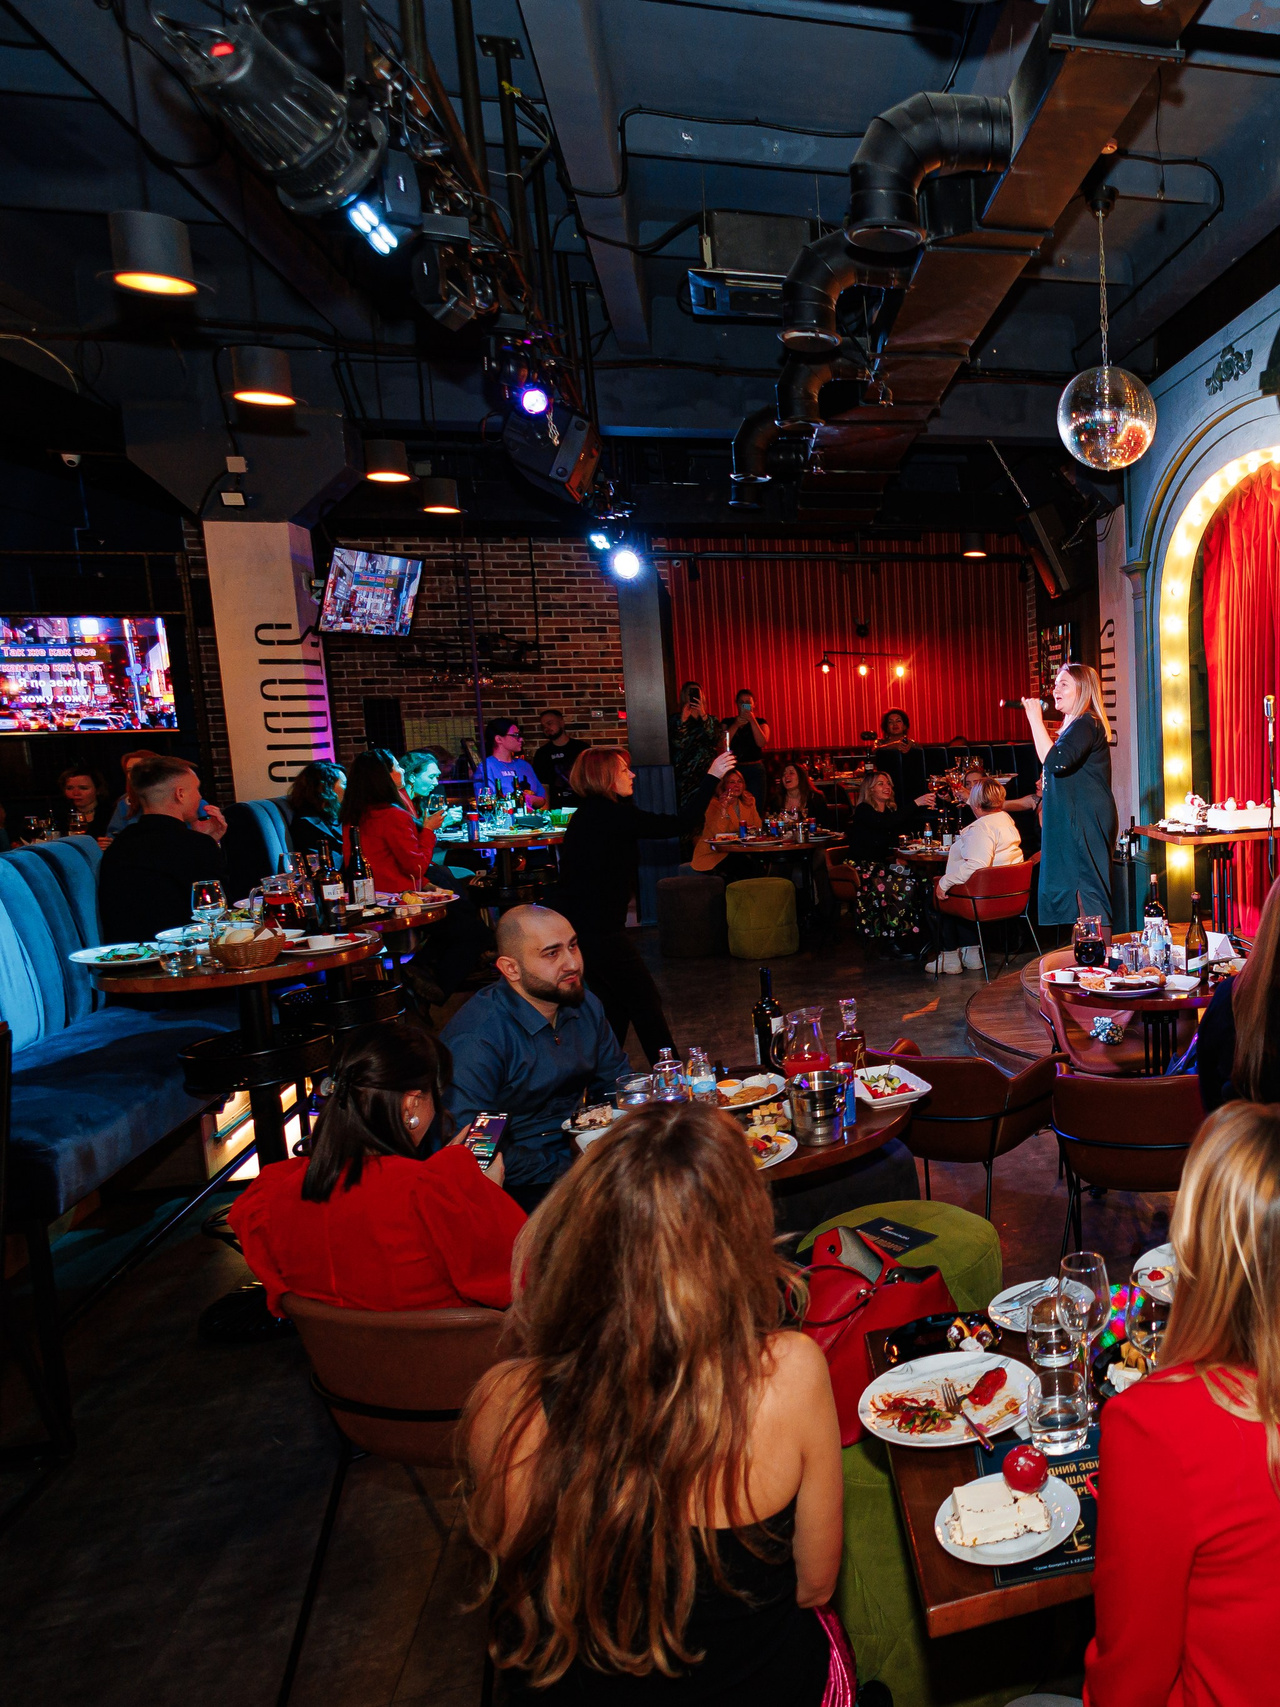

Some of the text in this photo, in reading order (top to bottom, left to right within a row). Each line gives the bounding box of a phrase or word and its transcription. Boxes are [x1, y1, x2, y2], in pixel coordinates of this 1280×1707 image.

[50, 648, 73, 657] как
[74, 648, 97, 657] все
[49, 679, 88, 688] земле
[20, 694, 91, 705] хожу хожу
[254, 623, 333, 783] STUDIO
